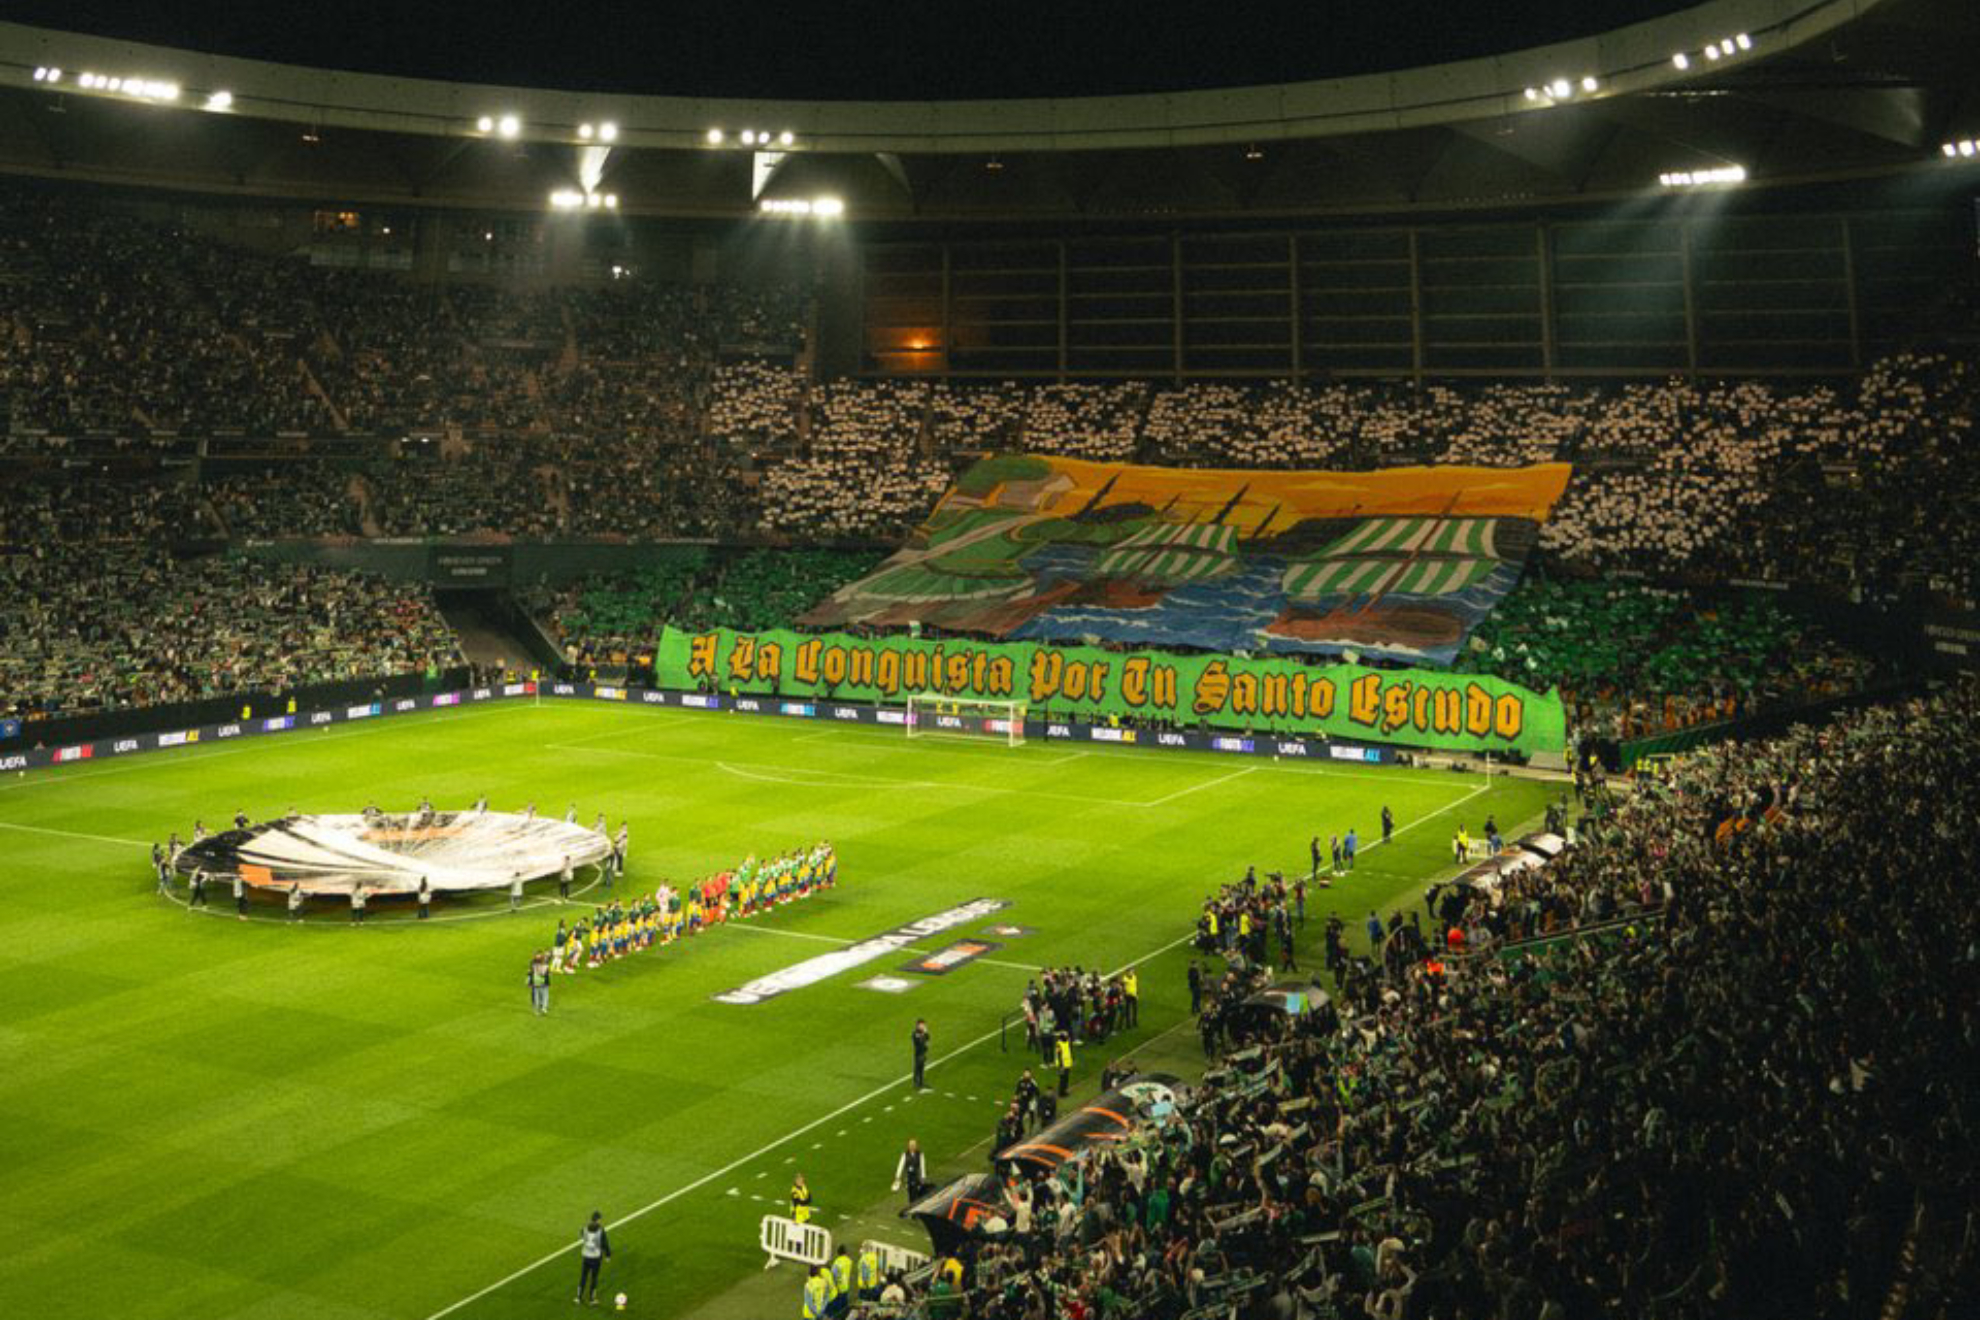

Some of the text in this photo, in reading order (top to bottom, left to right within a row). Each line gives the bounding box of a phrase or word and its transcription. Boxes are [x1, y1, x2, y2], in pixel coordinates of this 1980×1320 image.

[688, 633, 1523, 742] A La Conquista Por Tu Santo Escudo
[643, 692, 665, 702] UEFA
[736, 700, 760, 711] UEFA
[835, 707, 858, 719] UEFA
[936, 716, 962, 728] UEFA
[1158, 733, 1186, 745] UEFA
[114, 740, 138, 753] UEFA
[1278, 742, 1306, 755] UEFA
[0, 756, 26, 769] UEFA
